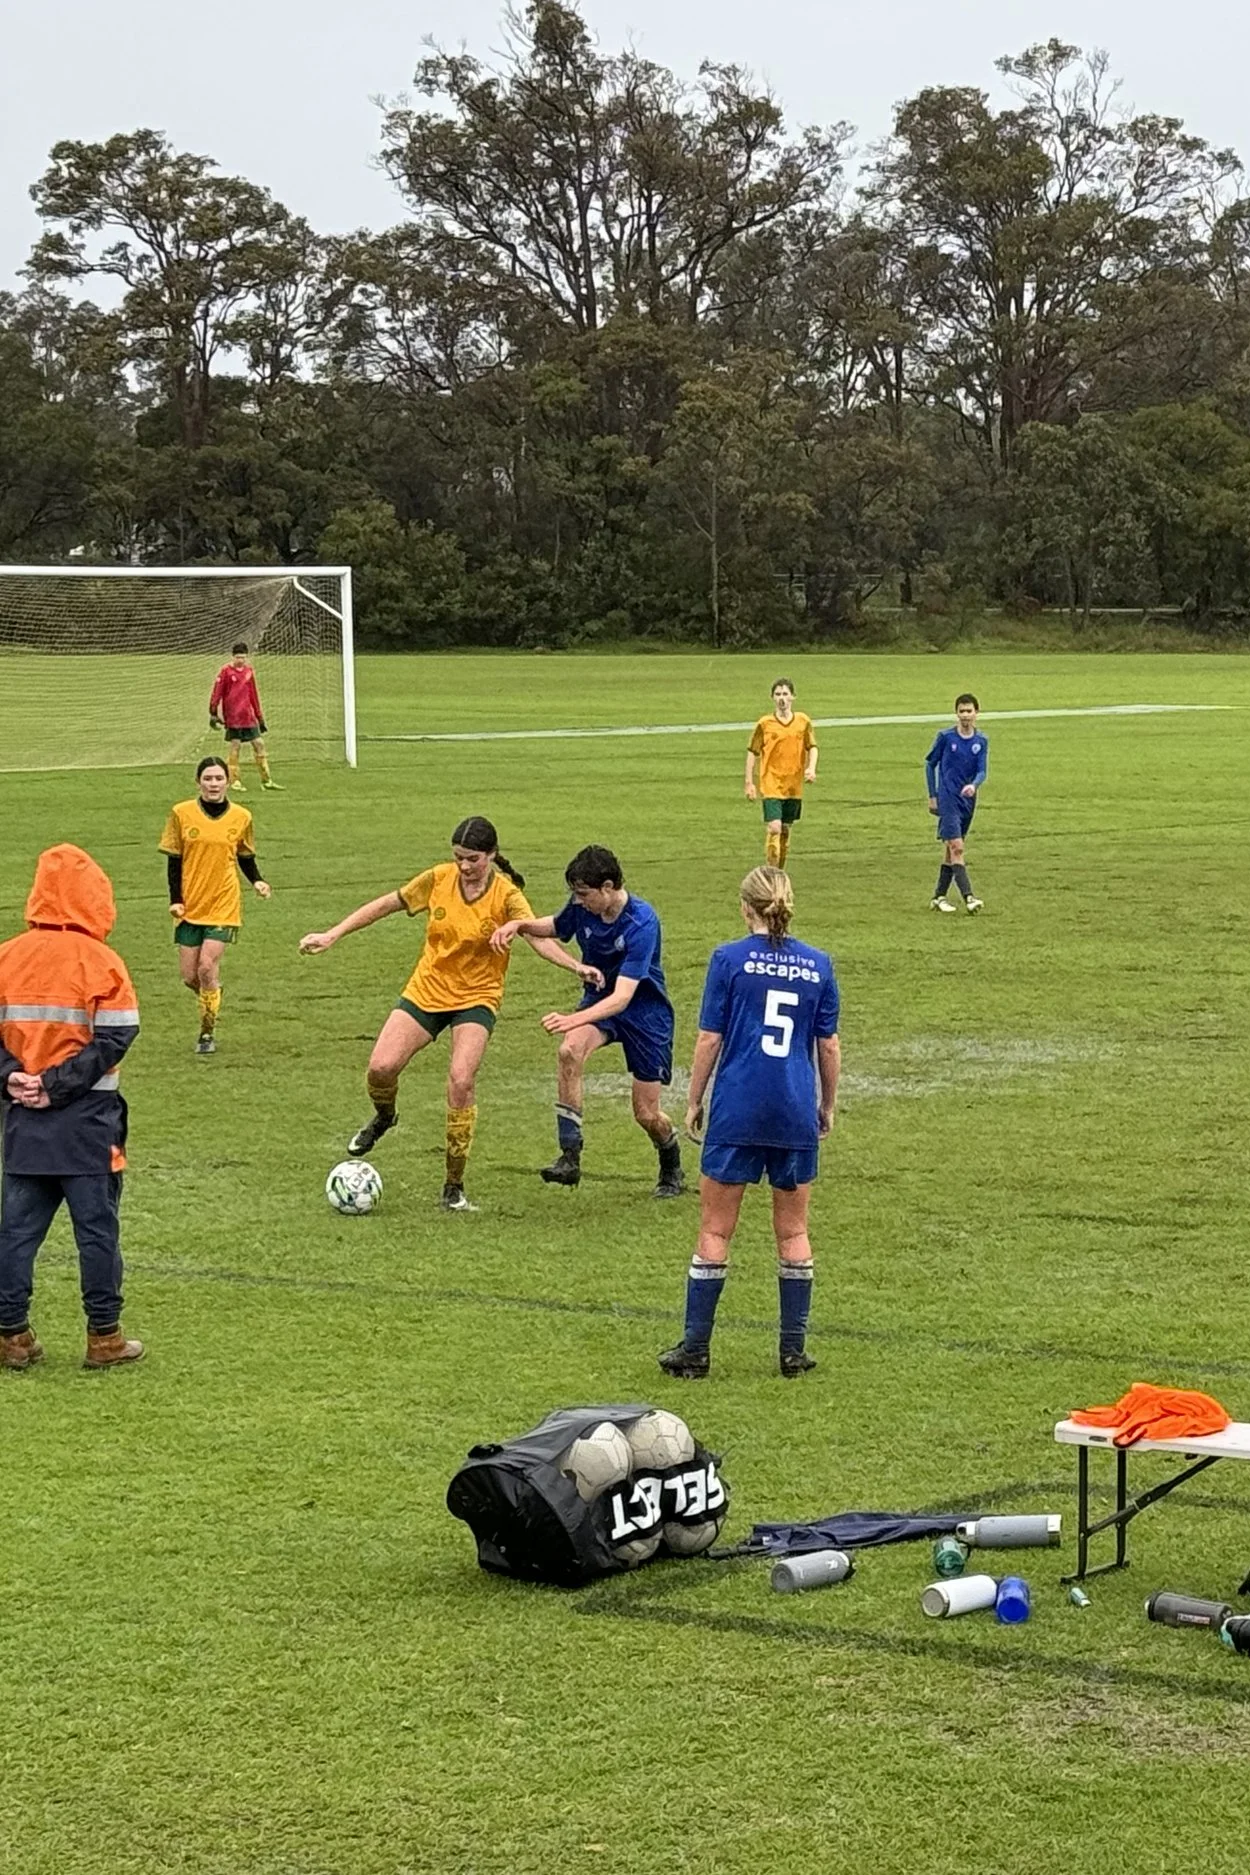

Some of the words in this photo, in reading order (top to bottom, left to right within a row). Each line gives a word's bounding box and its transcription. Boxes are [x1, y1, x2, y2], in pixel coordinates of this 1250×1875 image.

[743, 960, 821, 983] escapes
[749, 951, 816, 967] exclusive
[761, 989, 799, 1059] 5
[611, 1461, 725, 1540] SELECT
